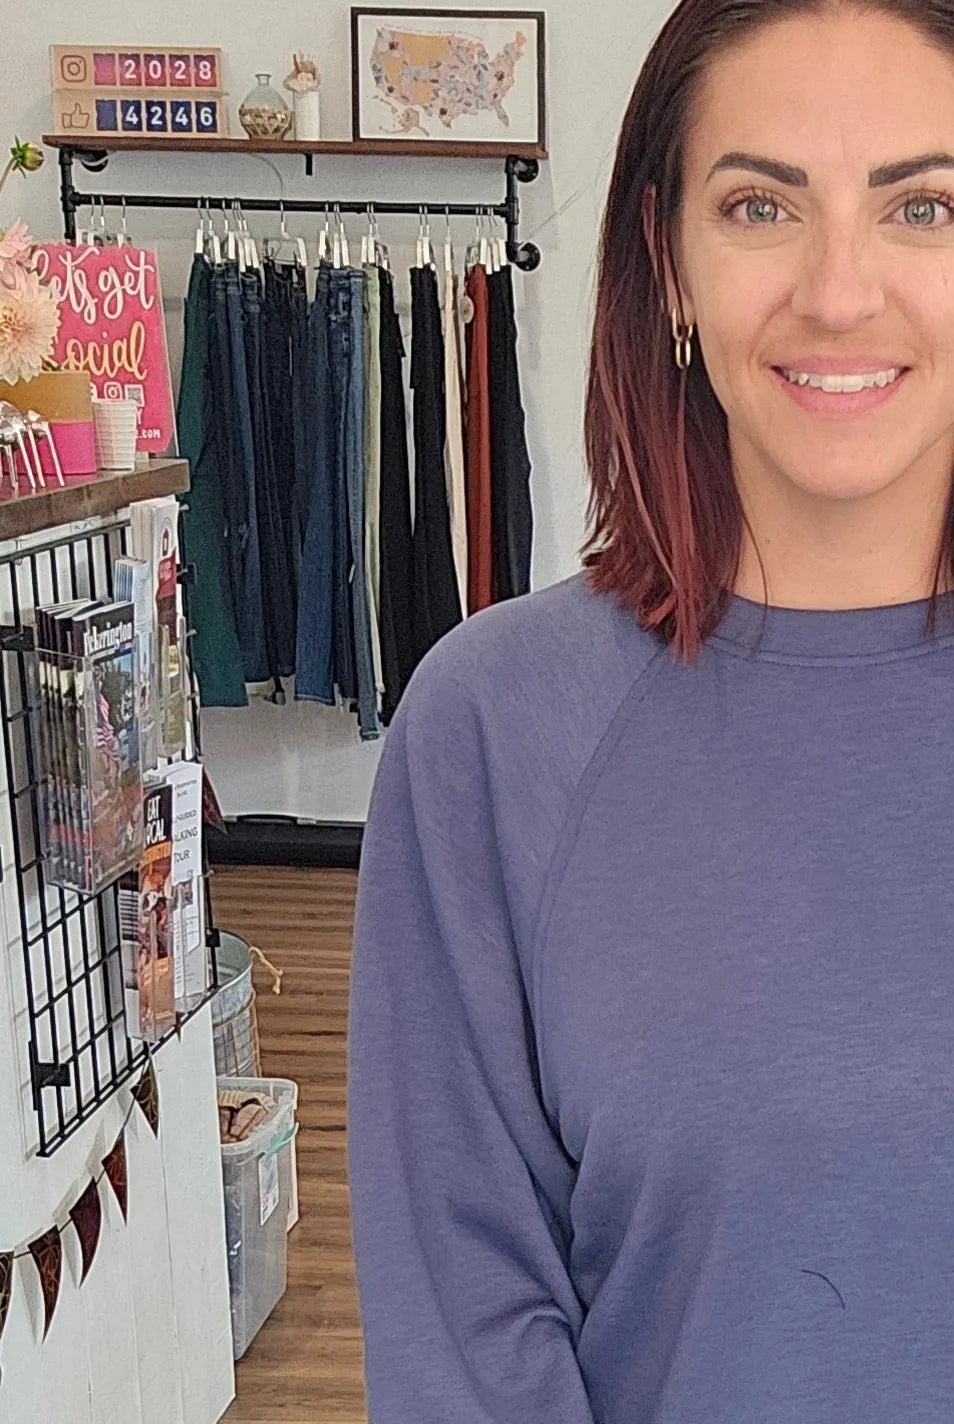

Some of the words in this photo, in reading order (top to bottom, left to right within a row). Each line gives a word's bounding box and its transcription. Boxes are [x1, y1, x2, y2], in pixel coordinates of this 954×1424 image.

[123, 59, 212, 81] 2028
[125, 105, 214, 127] 4246
[98, 250, 155, 320] get
[60, 320, 148, 381] ocial
[147, 794, 161, 822] EAT
